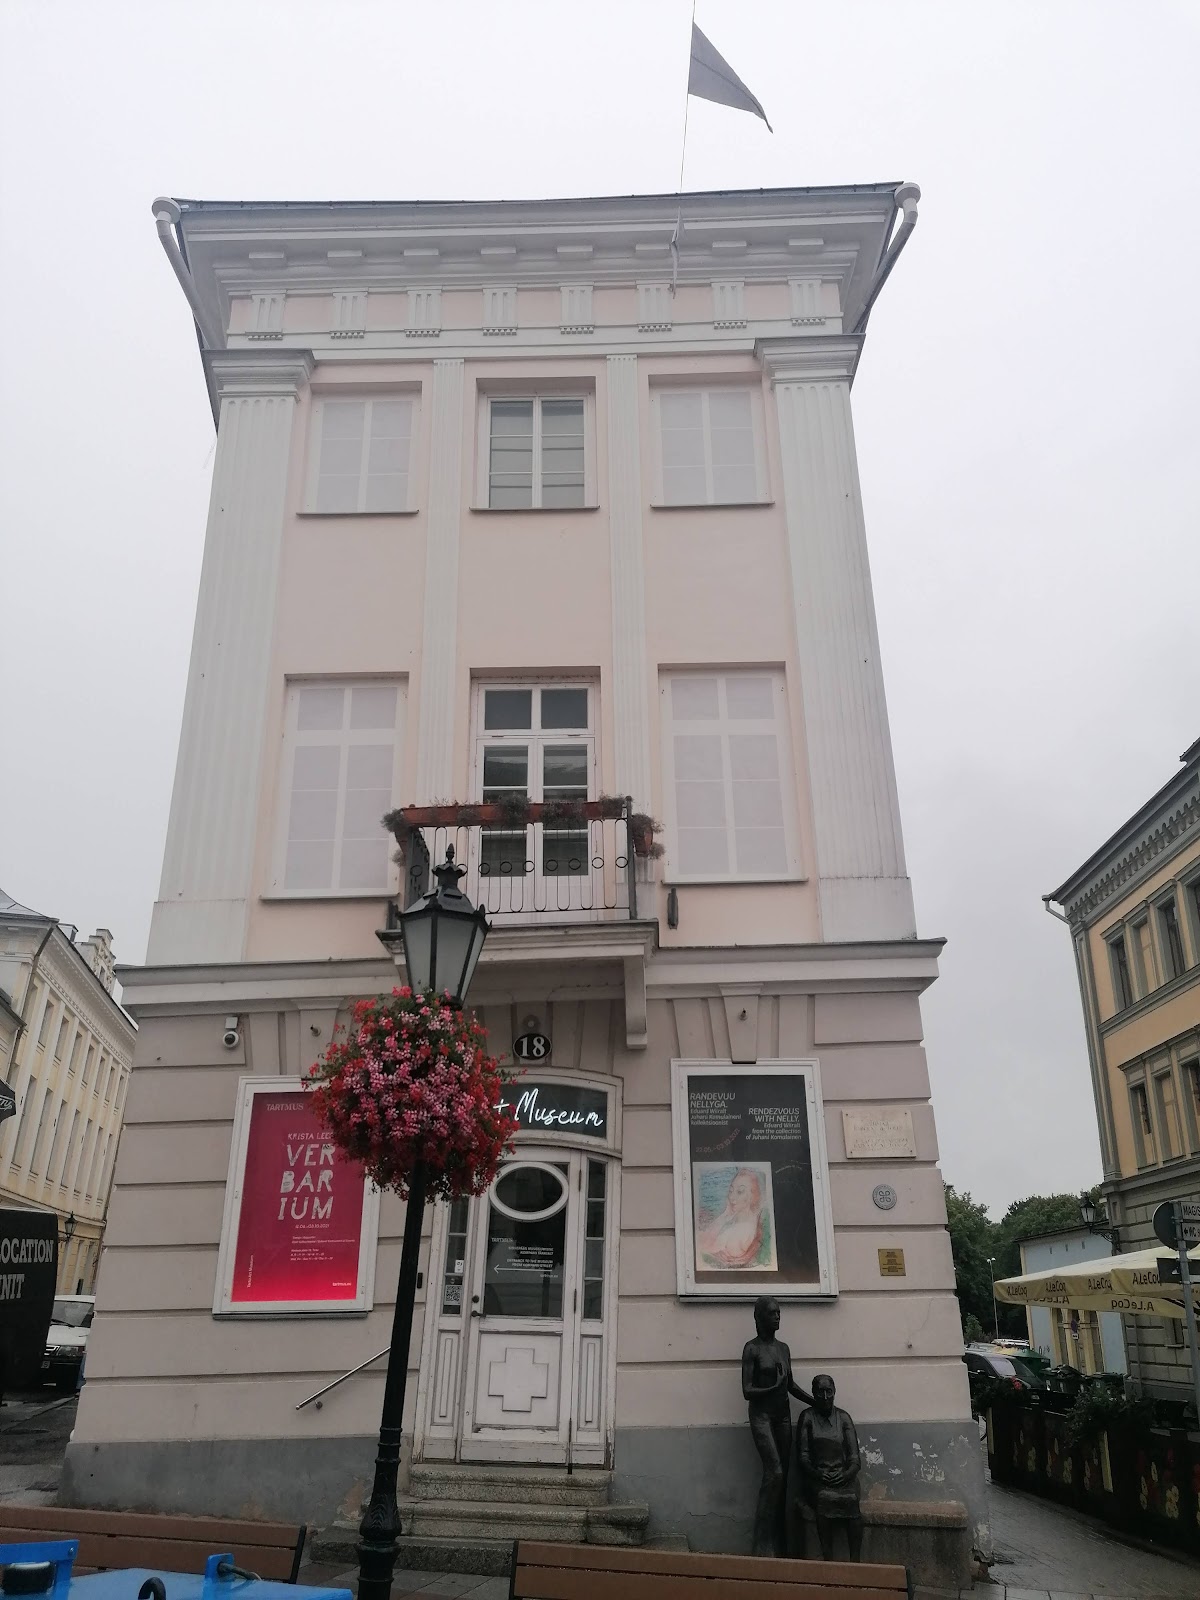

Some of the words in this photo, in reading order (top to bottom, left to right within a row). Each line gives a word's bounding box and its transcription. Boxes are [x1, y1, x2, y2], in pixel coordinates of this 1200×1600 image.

[520, 1036, 546, 1057] 18
[266, 1103, 304, 1111] TARTMUS
[514, 1088, 603, 1127] Museum
[690, 1100, 728, 1108] NELLYGA.
[748, 1107, 800, 1115] RENDEZVOUS
[287, 1144, 336, 1167] VER
[280, 1170, 334, 1194] BAR
[278, 1196, 334, 1221] IUM
[0, 1238, 54, 1263] OCATION
